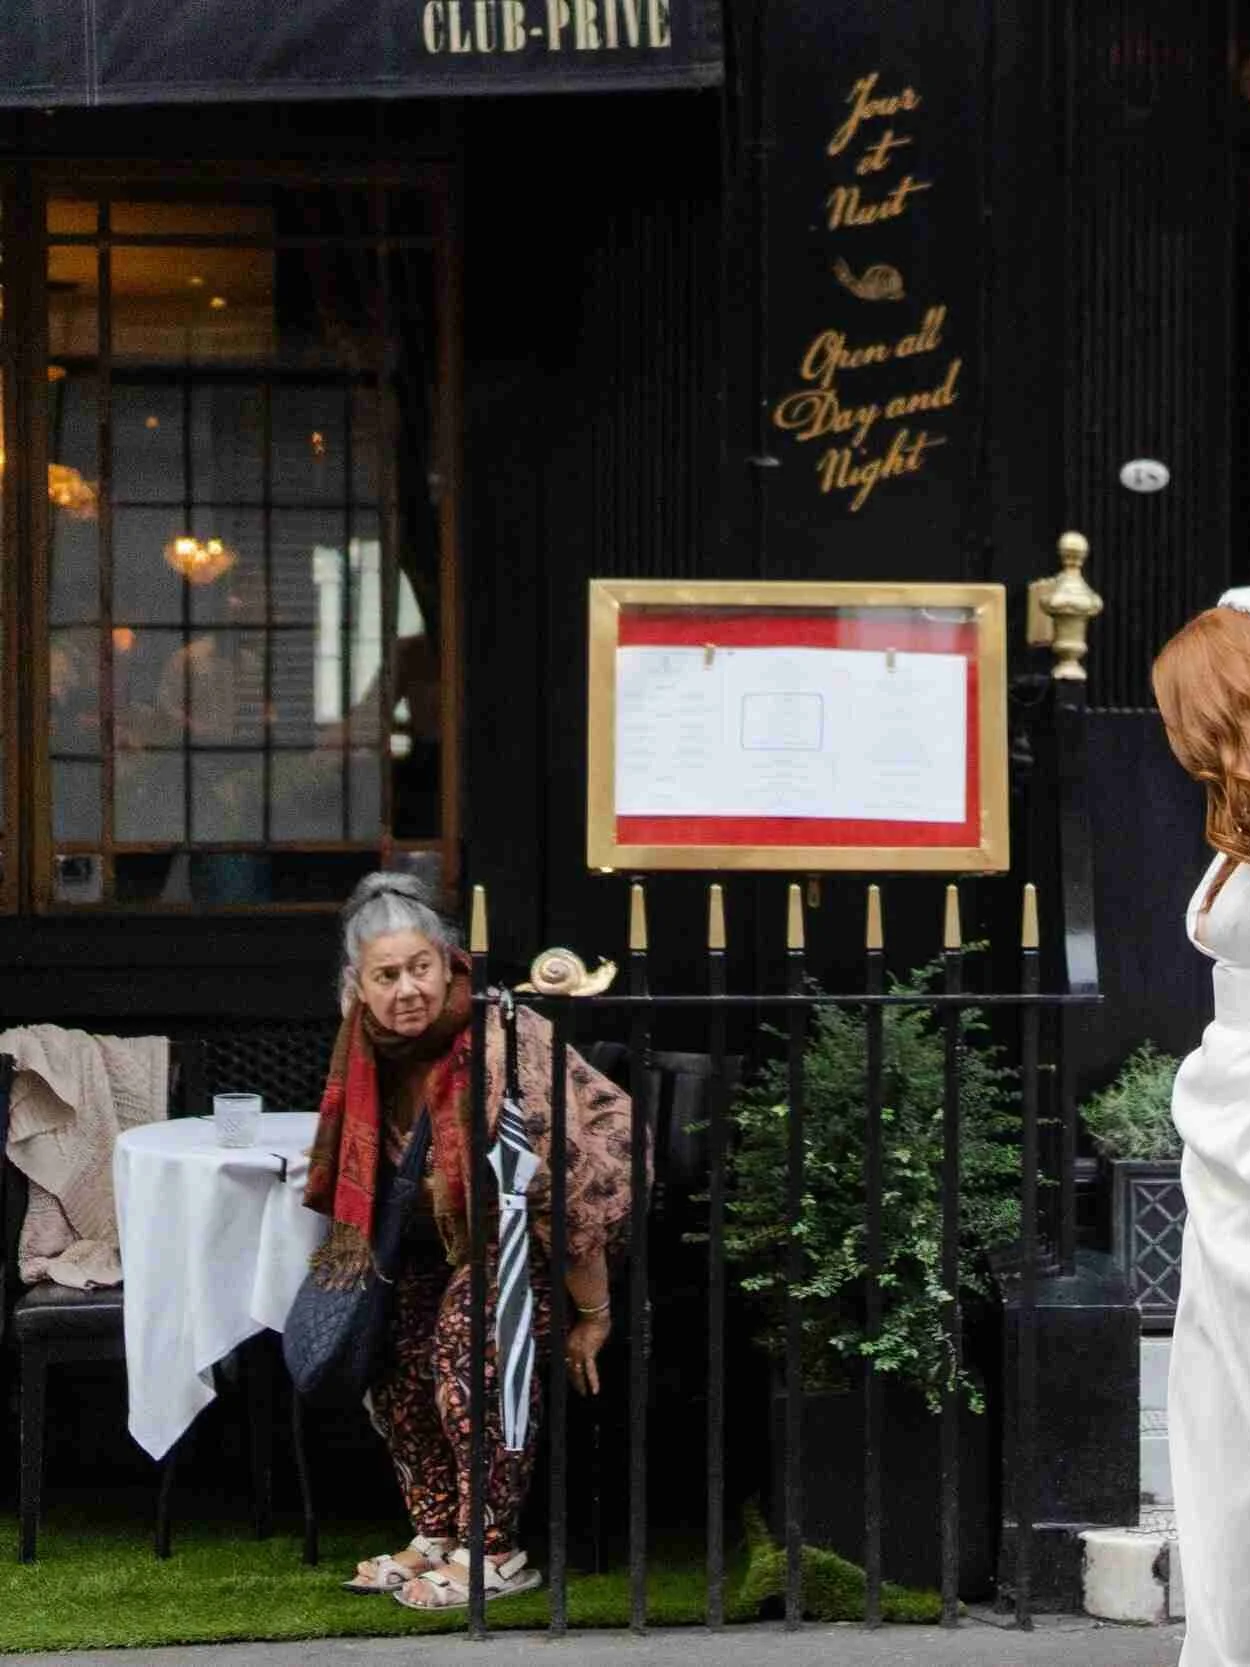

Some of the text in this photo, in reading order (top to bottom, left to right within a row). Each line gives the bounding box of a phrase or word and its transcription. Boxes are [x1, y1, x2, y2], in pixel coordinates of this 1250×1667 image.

[827, 72, 923, 156] Jour
[801, 304, 946, 389] Open all
[773, 357, 962, 448] Day and
[816, 427, 947, 512] Night
